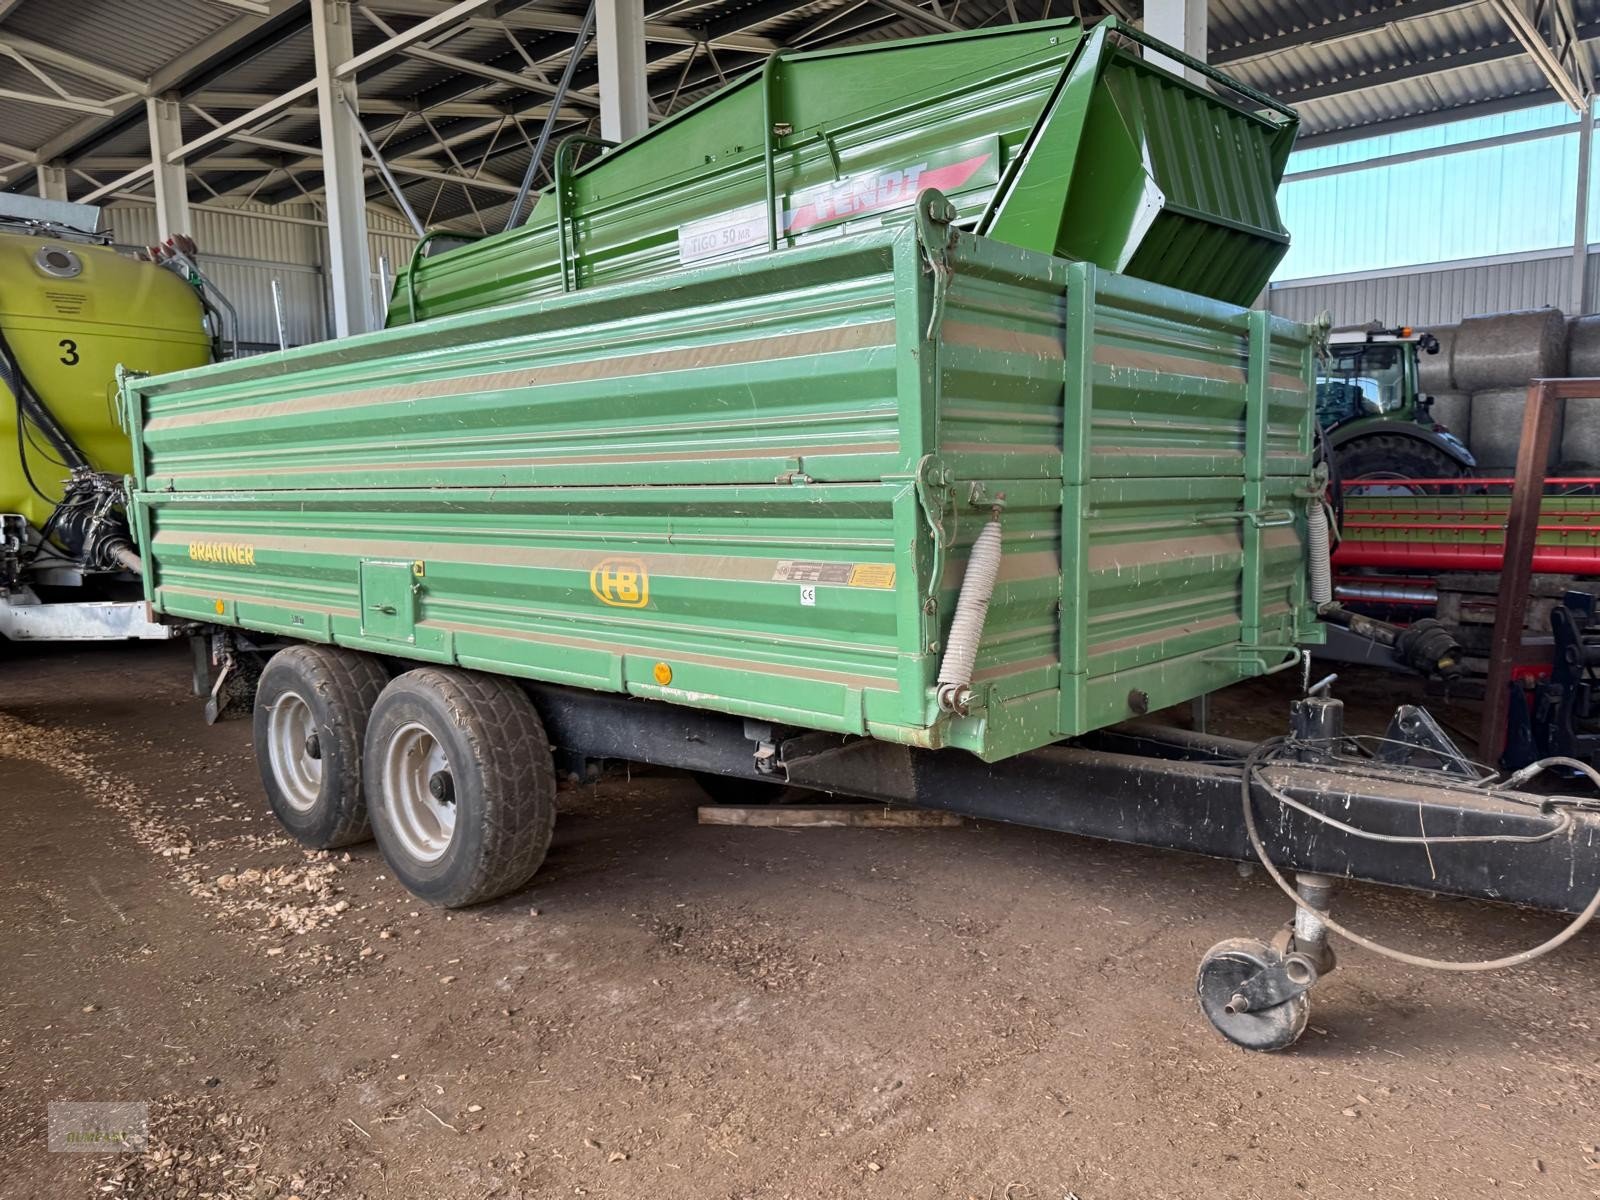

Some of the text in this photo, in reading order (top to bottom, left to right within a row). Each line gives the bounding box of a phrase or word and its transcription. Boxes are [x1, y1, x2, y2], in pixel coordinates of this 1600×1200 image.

[814, 162, 928, 219] FENDT
[691, 234, 717, 253] TIGO
[722, 228, 736, 244] 50
[59, 340, 80, 366] 3
[189, 542, 256, 566] BRANTNER
[602, 565, 639, 600] HB
